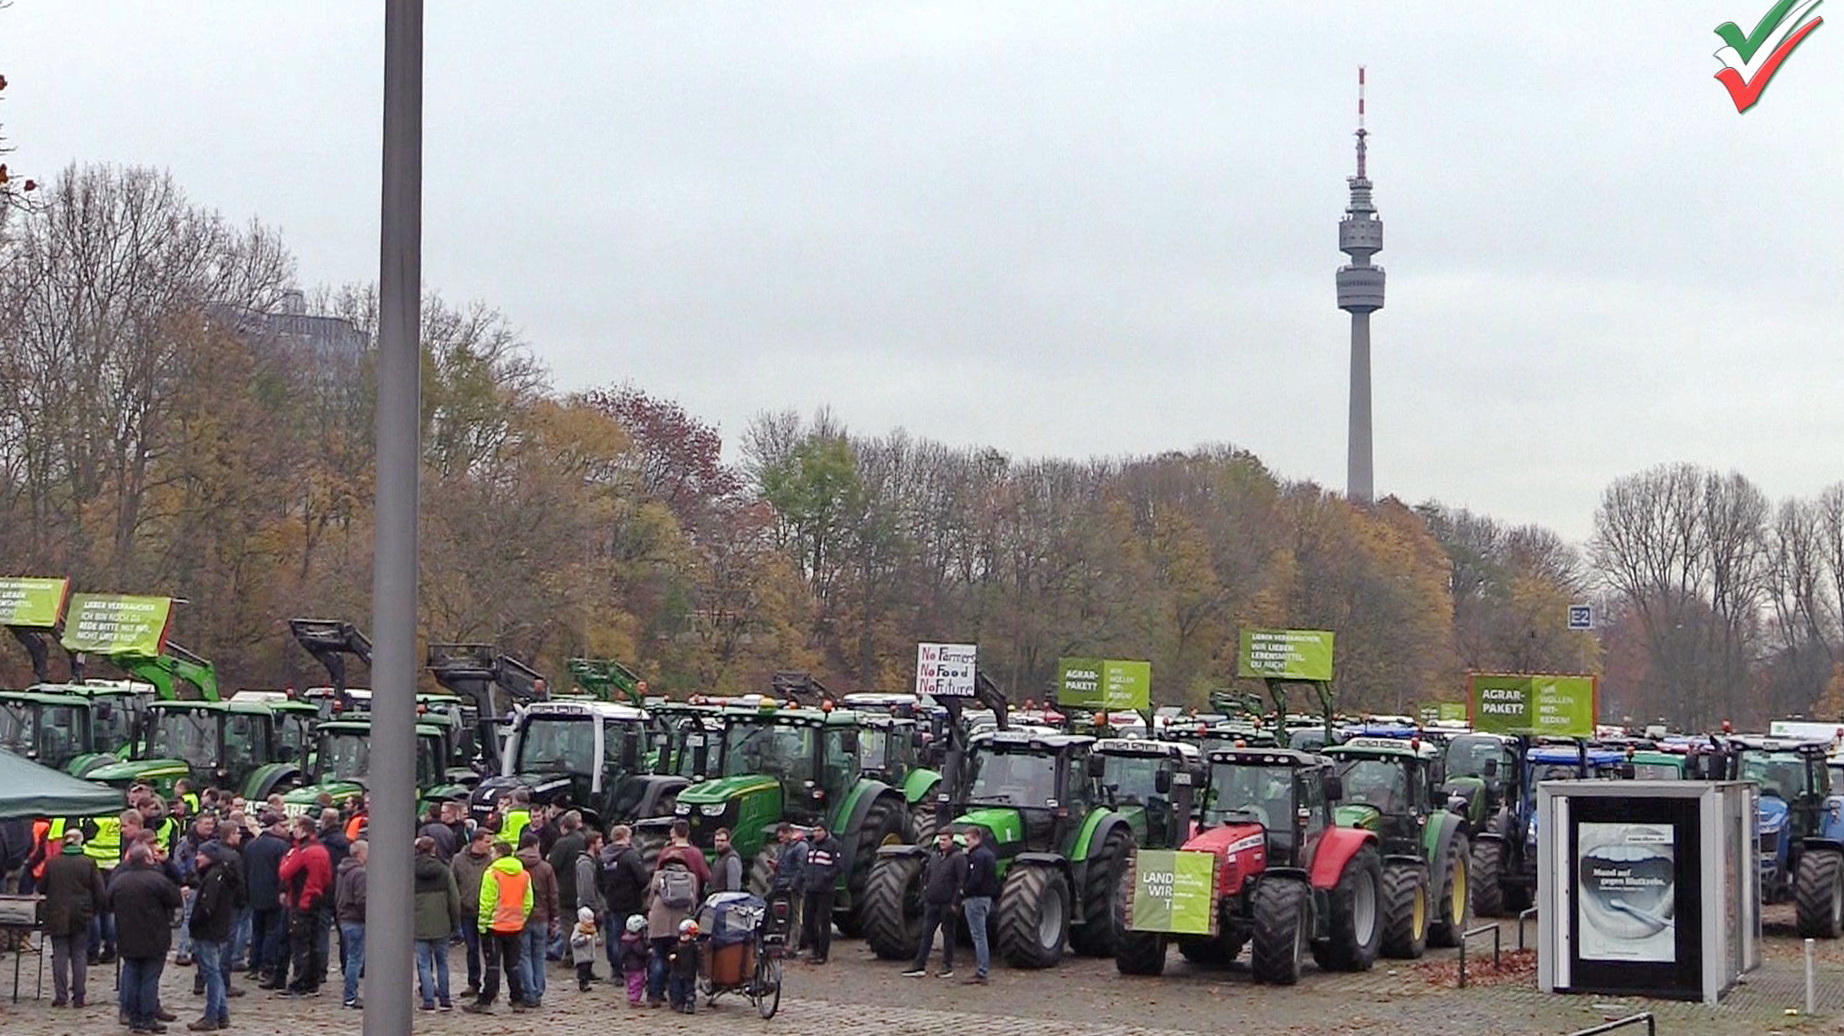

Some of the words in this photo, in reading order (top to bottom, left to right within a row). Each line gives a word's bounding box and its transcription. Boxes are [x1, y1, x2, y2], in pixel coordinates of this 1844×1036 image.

[84, 601, 106, 609] LIEBER
[1572, 610, 1589, 623] E2
[79, 621, 97, 630] REDE
[99, 622, 119, 631] BITTE
[1268, 643, 1295, 652] LIEBEN
[922, 647, 936, 660] No
[921, 664, 935, 677] No
[937, 664, 968, 677] Food
[1065, 670, 1099, 680] AGRAR-
[920, 678, 935, 692] No
[936, 678, 973, 693] Future
[1065, 681, 1097, 691] PAKET?
[1482, 689, 1526, 700] AGRAR-
[1540, 696, 1574, 704] WOLLEN
[1482, 703, 1524, 714] PAKET?
[1142, 871, 1174, 884] LAND
[1593, 868, 1616, 877] Mund
[1617, 868, 1632, 877] auf
[1600, 878, 1624, 887] gegen
[1148, 885, 1173, 897] WIR
[1164, 898, 1172, 910] T
